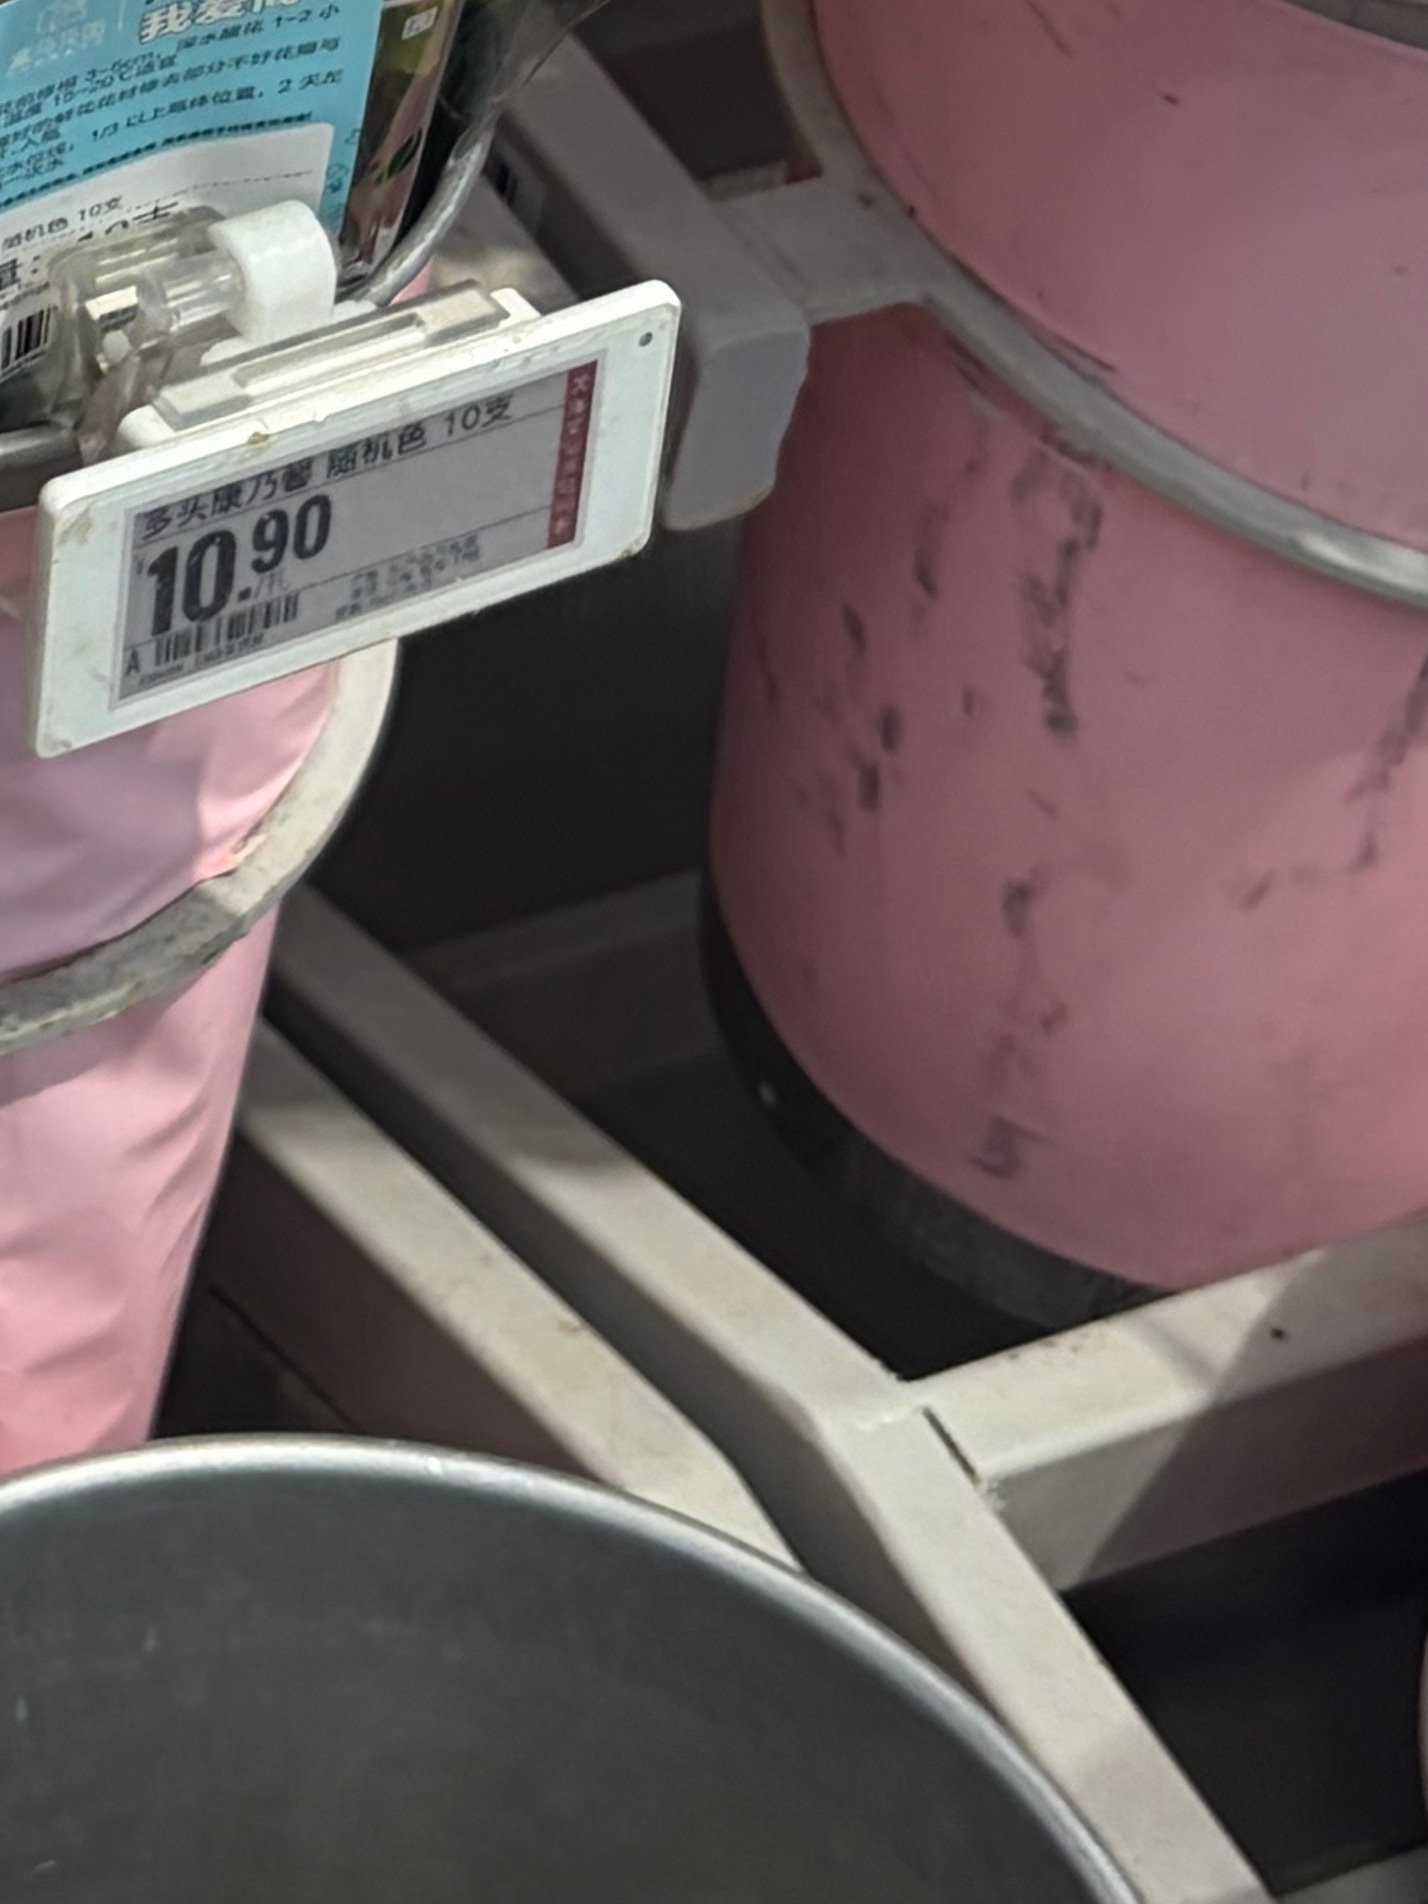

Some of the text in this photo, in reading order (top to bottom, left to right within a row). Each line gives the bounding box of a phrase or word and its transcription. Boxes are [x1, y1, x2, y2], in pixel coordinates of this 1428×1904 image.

[277, 77, 294, 96] 2
[77, 195, 123, 221] 10支
[142, 393, 516, 540] 多头康乃馨 随机色 10支
